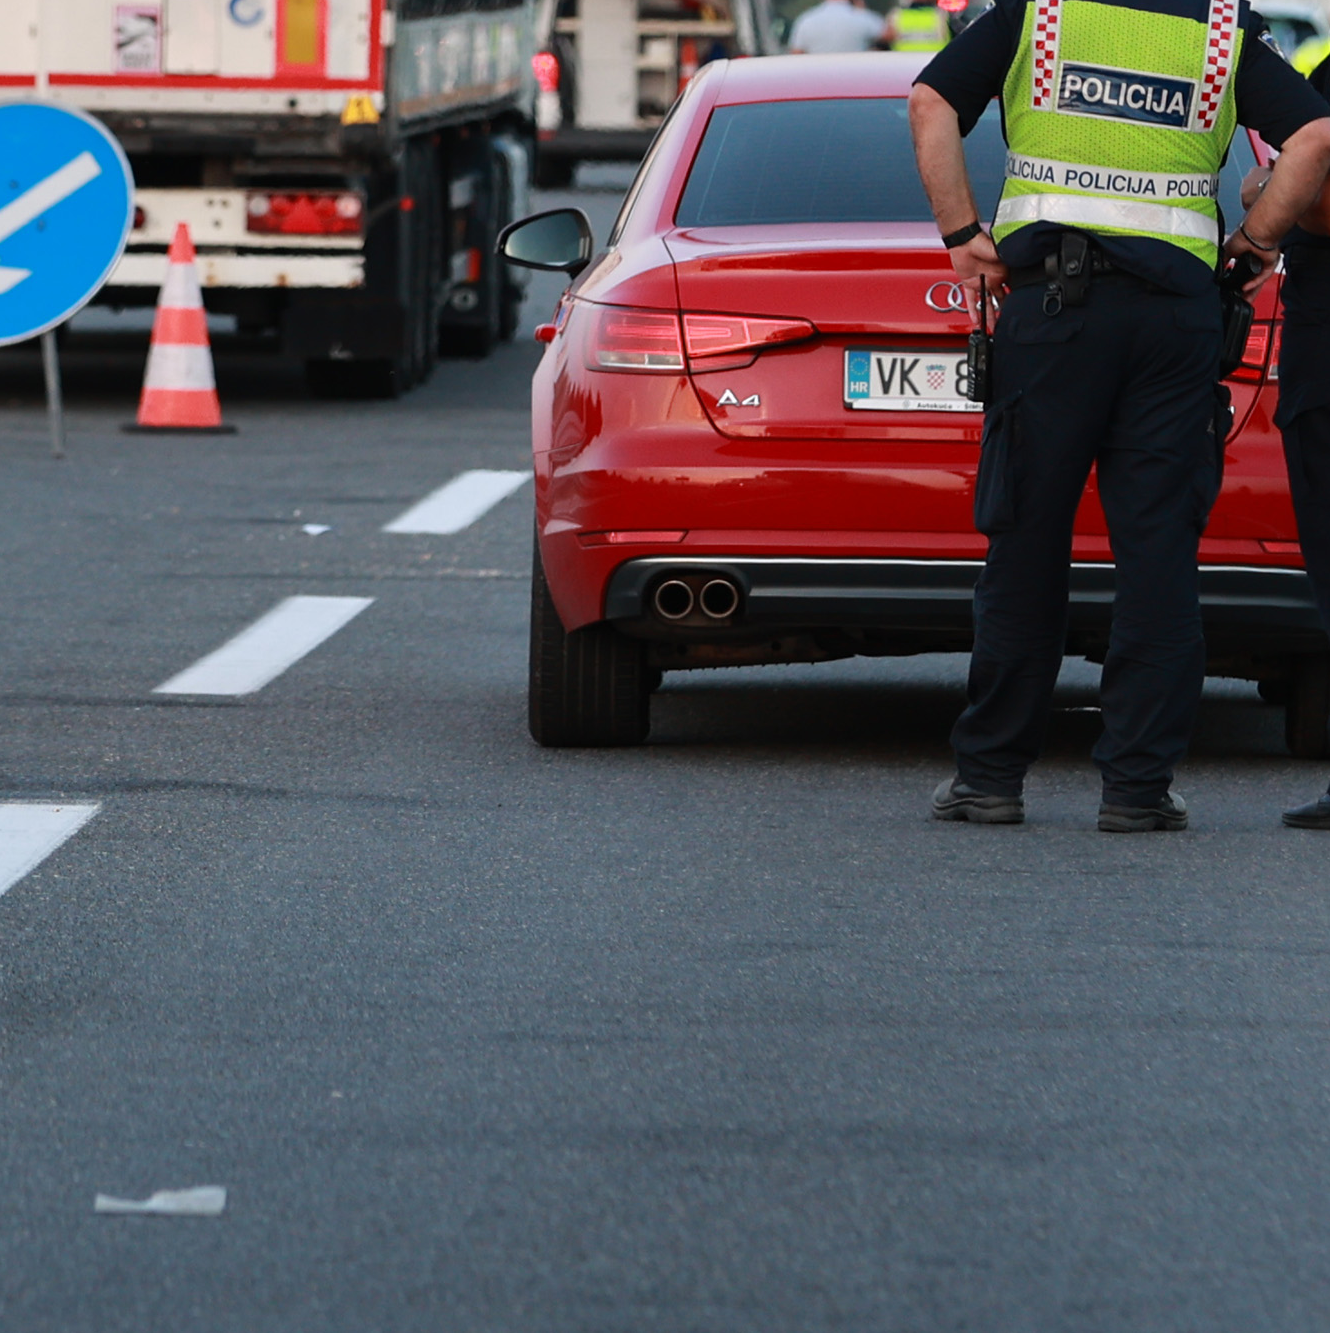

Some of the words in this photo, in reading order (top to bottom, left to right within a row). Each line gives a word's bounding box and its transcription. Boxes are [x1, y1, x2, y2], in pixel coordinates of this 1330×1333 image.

[1063, 74, 1186, 116] POLICIJA
[1064, 169, 1157, 195] POLICIJA
[850, 381, 868, 393] HR
[876, 357, 921, 396] VK
[716, 388, 761, 407] A4
